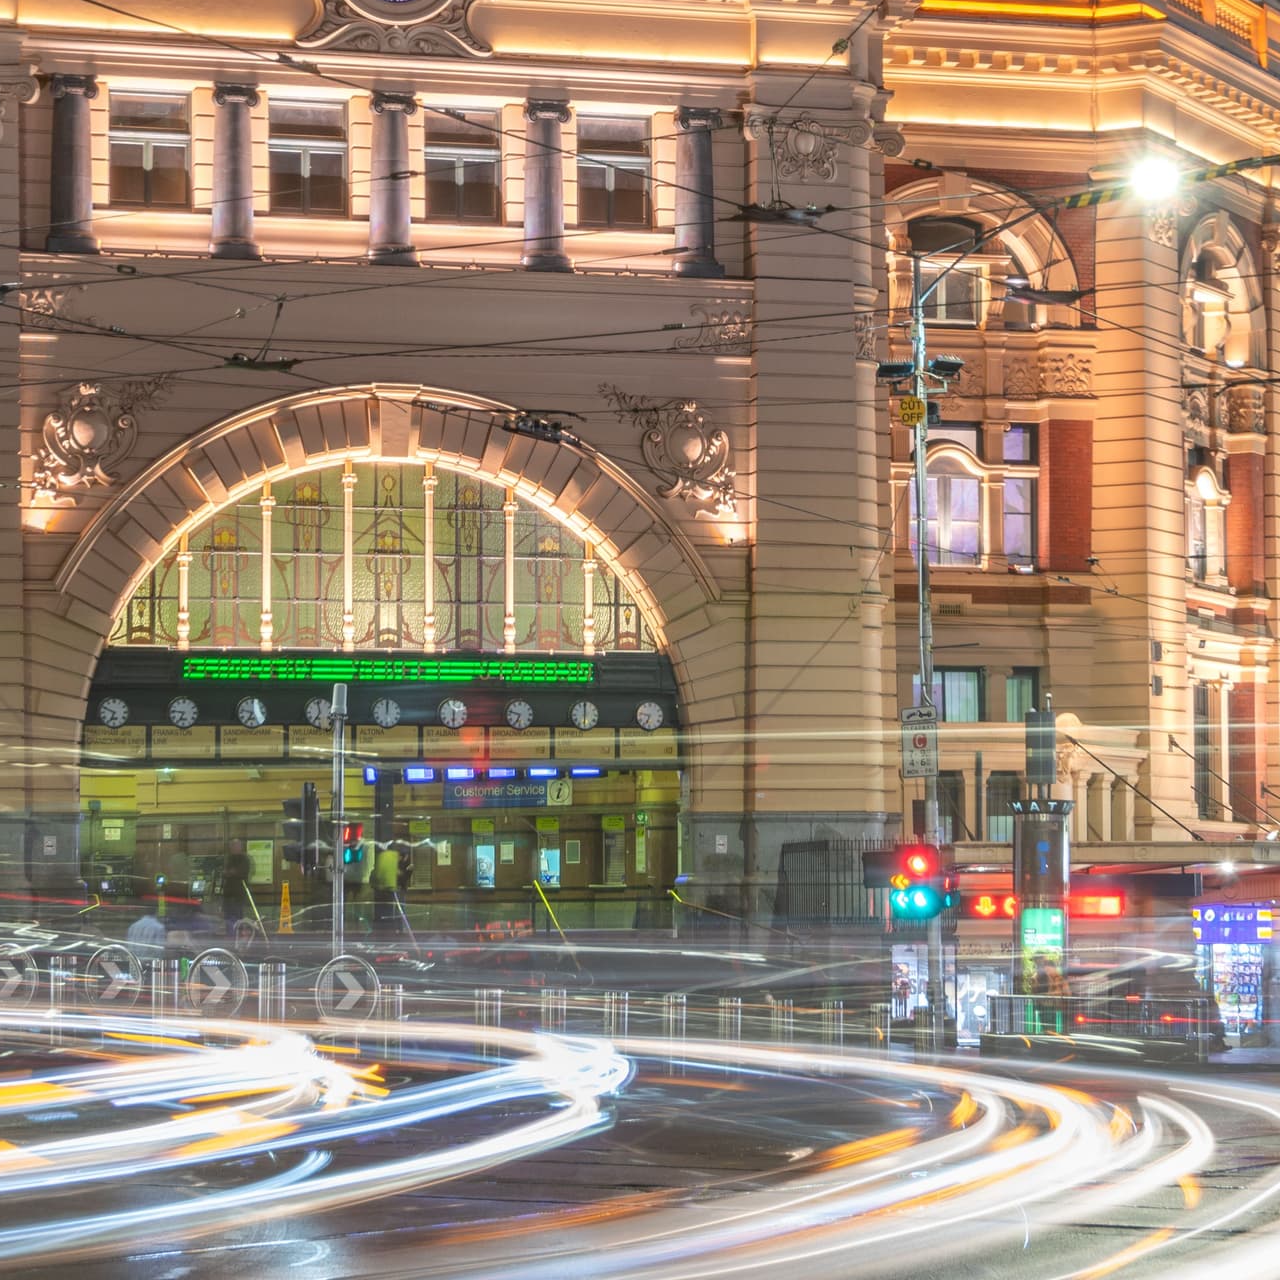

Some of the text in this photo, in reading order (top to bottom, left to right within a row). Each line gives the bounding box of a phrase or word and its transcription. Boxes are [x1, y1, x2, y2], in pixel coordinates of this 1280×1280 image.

[900, 401, 920, 410] CUT
[902, 413, 923, 422] OFF
[454, 785, 505, 797] Customer
[506, 784, 545, 796] Service
